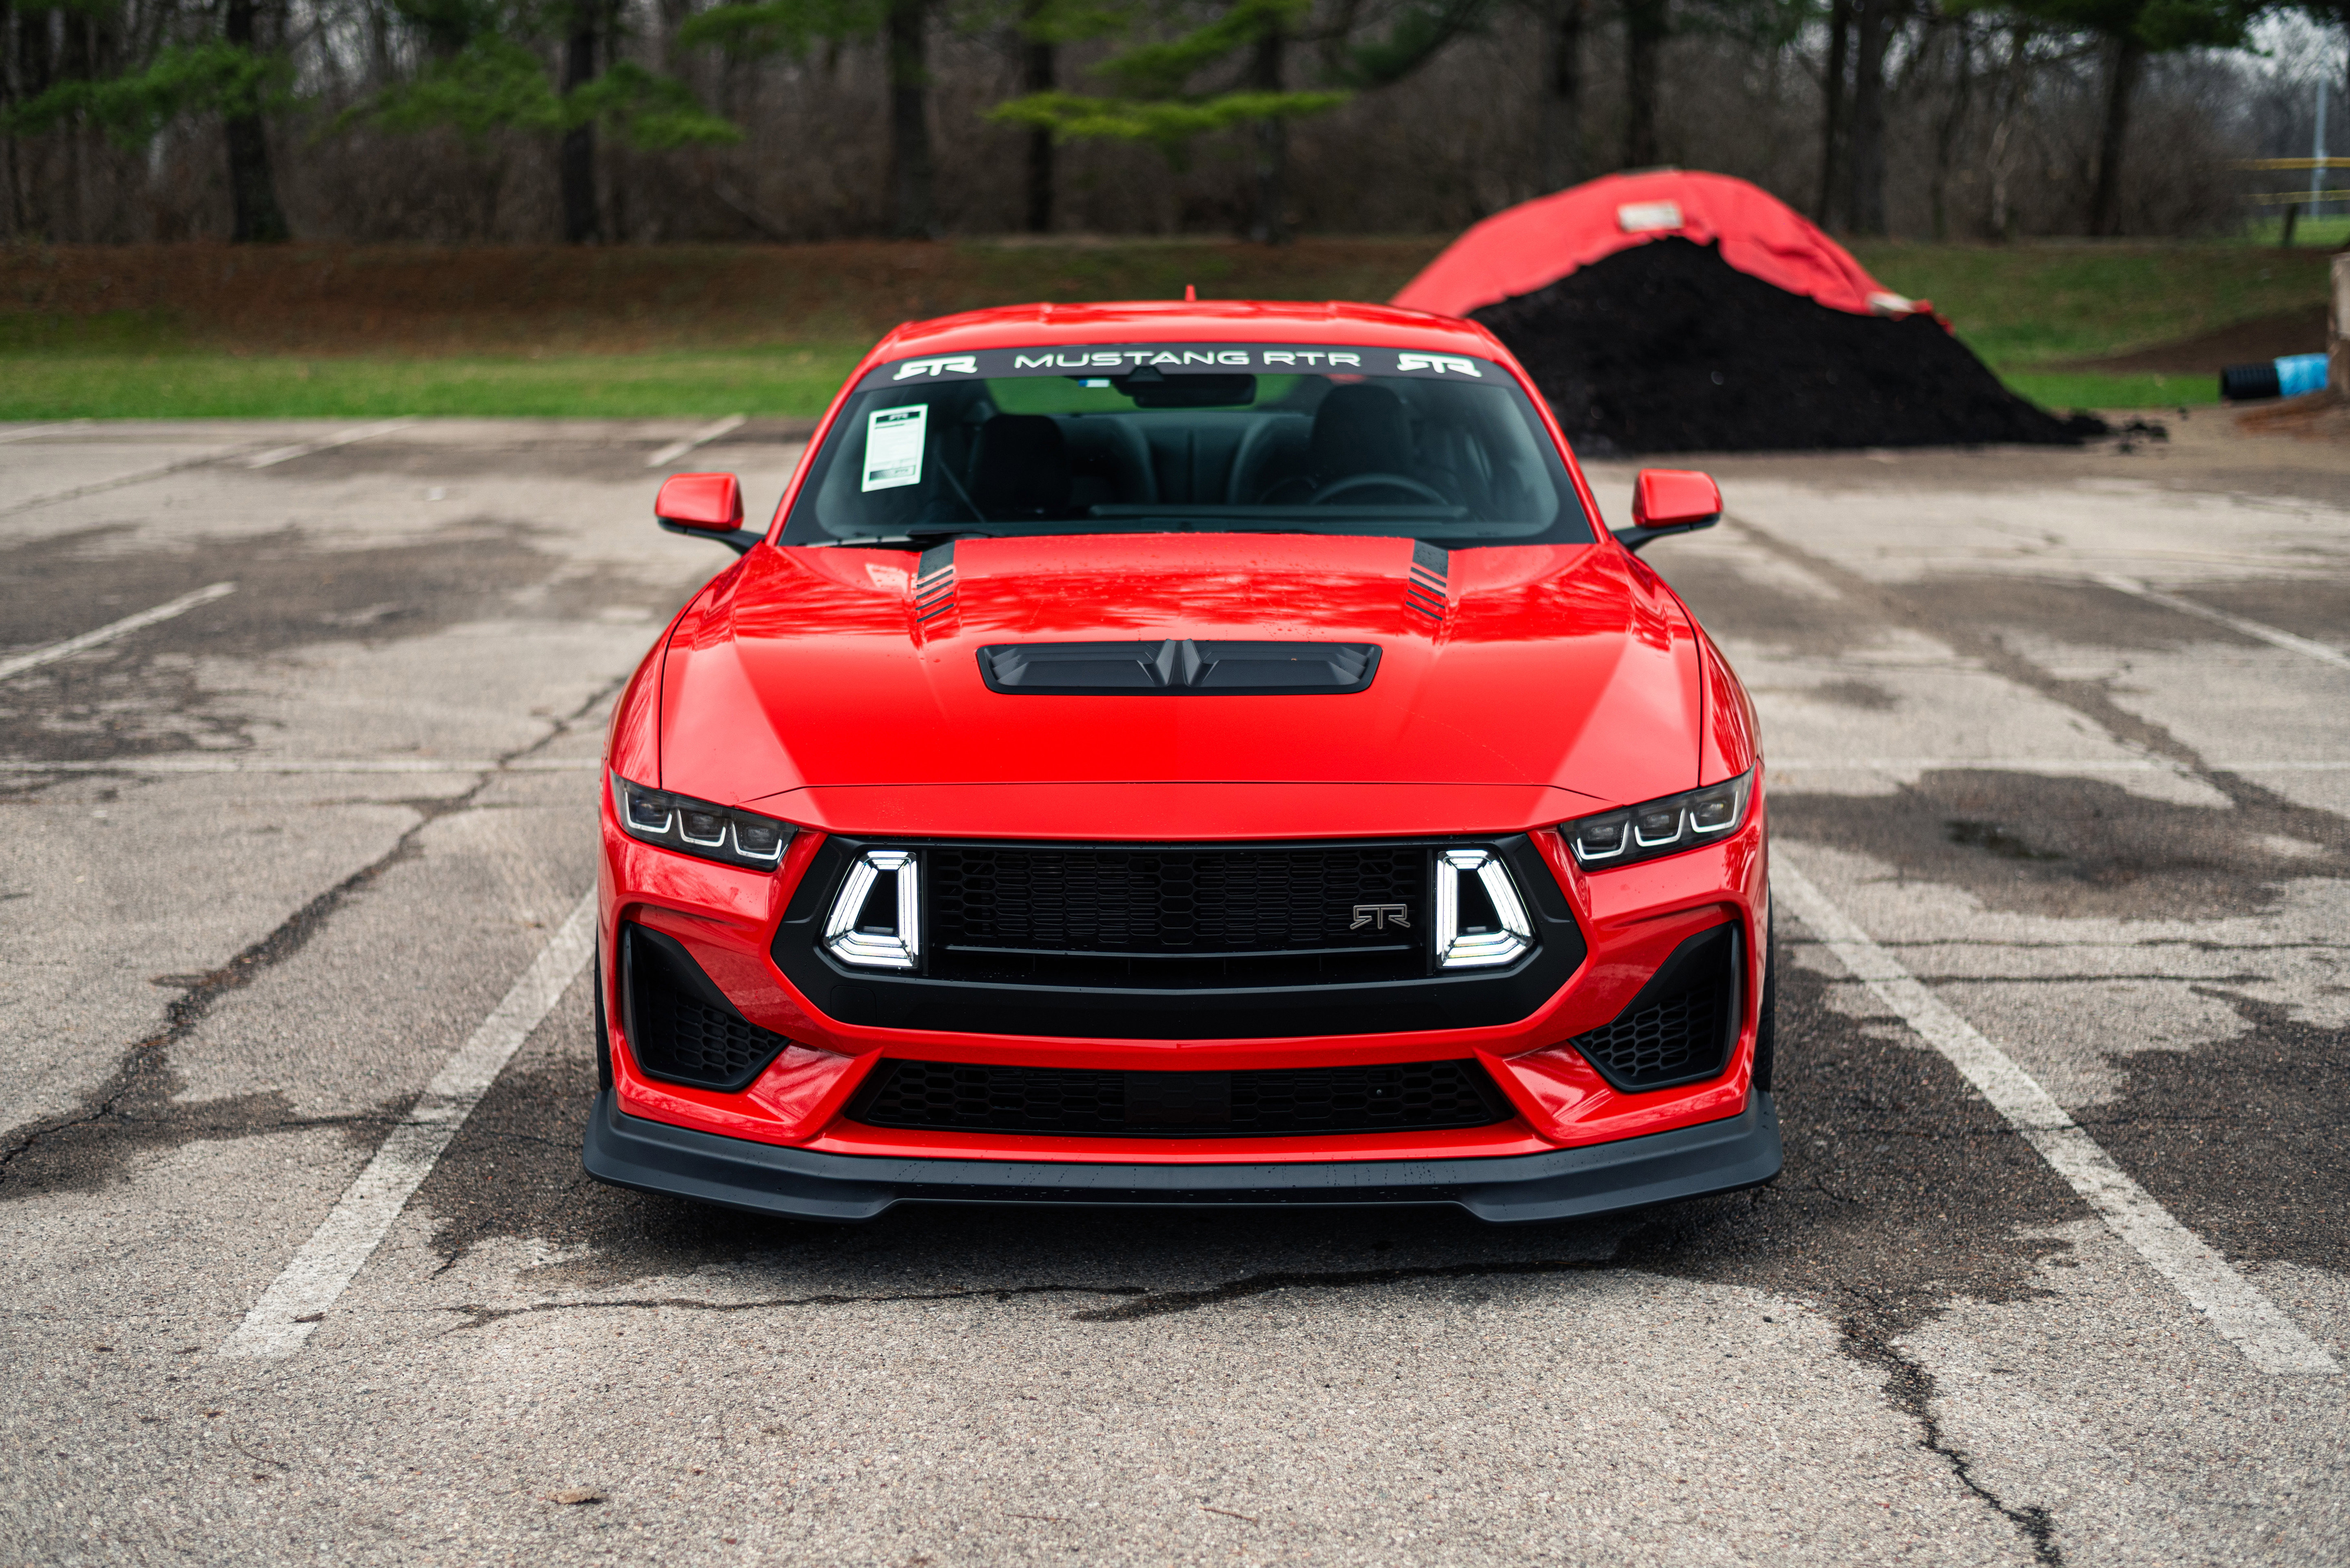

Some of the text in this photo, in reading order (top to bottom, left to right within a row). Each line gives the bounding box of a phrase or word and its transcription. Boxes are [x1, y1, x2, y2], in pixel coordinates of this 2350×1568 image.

[1014, 350, 1361, 368] MUSTANG RTR
[1349, 903, 1411, 930] RTR
